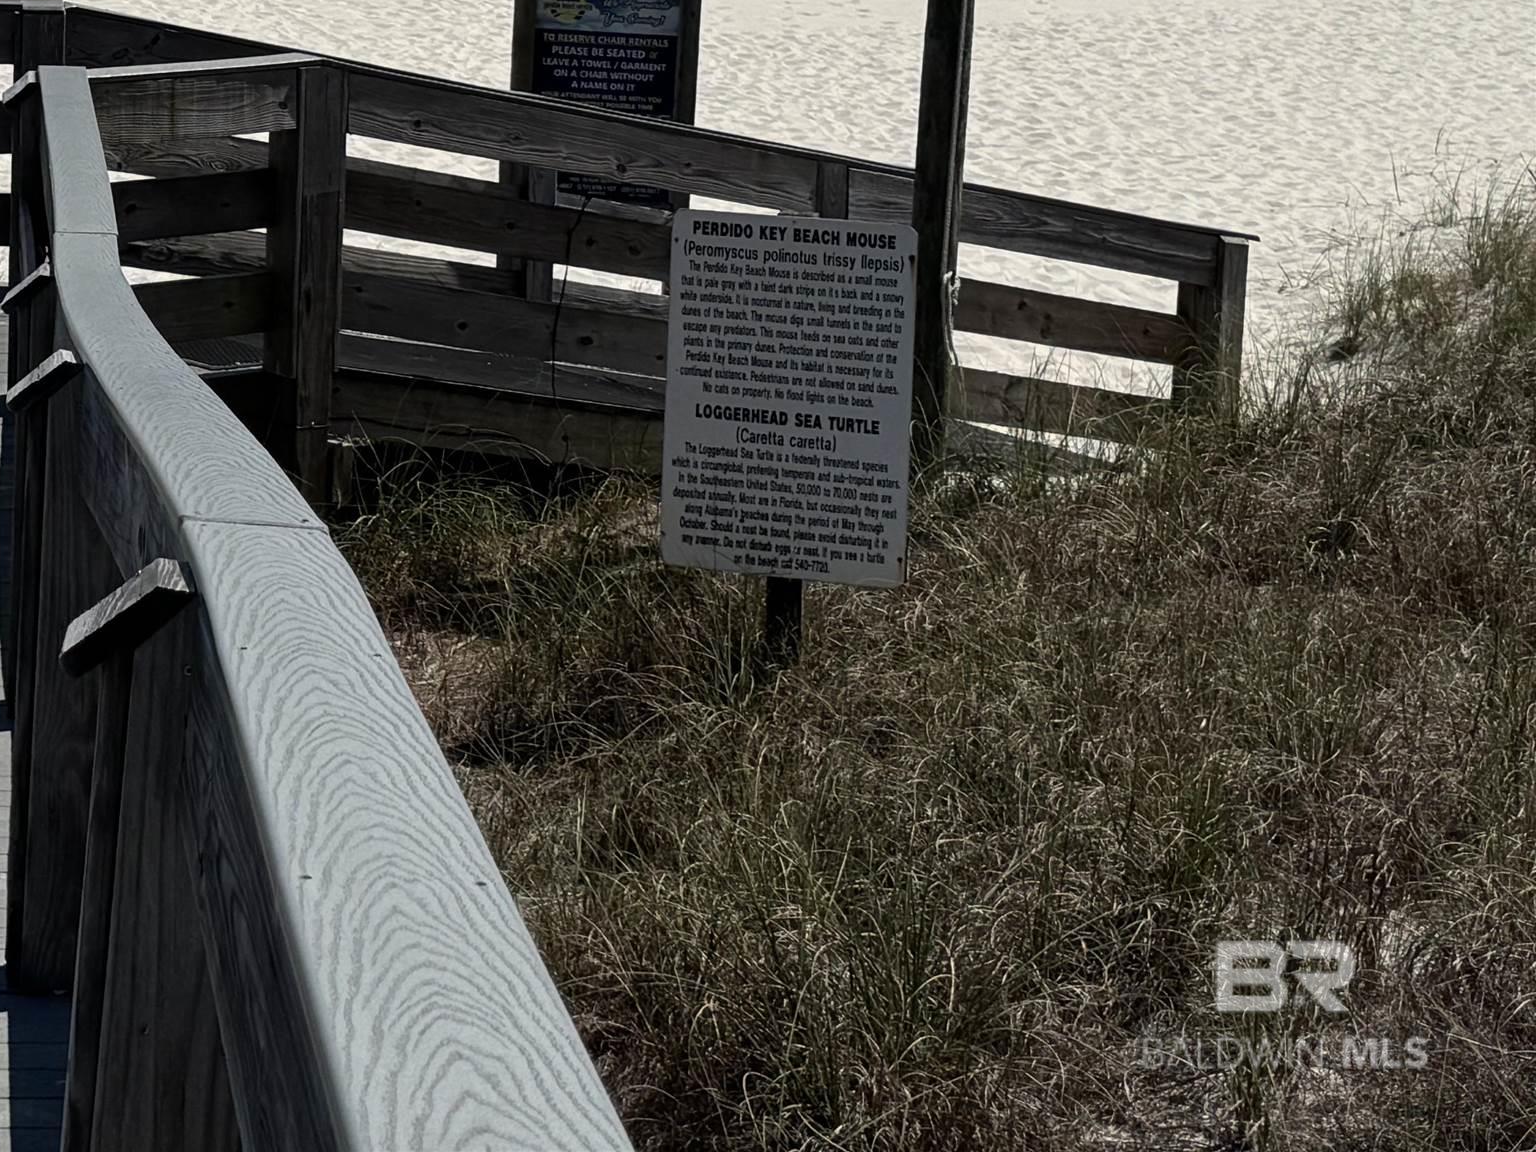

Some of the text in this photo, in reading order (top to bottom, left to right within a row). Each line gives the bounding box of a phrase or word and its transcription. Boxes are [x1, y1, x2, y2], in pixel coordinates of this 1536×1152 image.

[544, 33, 669, 47] TO RESERVE CHAIR RENTALS
[552, 45, 589, 56] PLEASE
[591, 47, 604, 57] BE
[606, 48, 646, 59] SEATED
[543, 57, 569, 66] LEAVE
[571, 59, 579, 67] A
[581, 59, 612, 68] TOWEL
[620, 61, 667, 71] GARMENT
[553, 69, 655, 82] ON A CHAIR WITHOUT
[571, 80, 635, 91] A NAME ON IT
[693, 220, 896, 250] PERDIDO KEY BEACH MOUSE
[684, 239, 758, 263] (Peromyscus
[763, 247, 817, 268] polinotus
[696, 403, 880, 435] LOGGERHEAD SEA TURTLE
[736, 426, 836, 453] (Caretta caretta)
